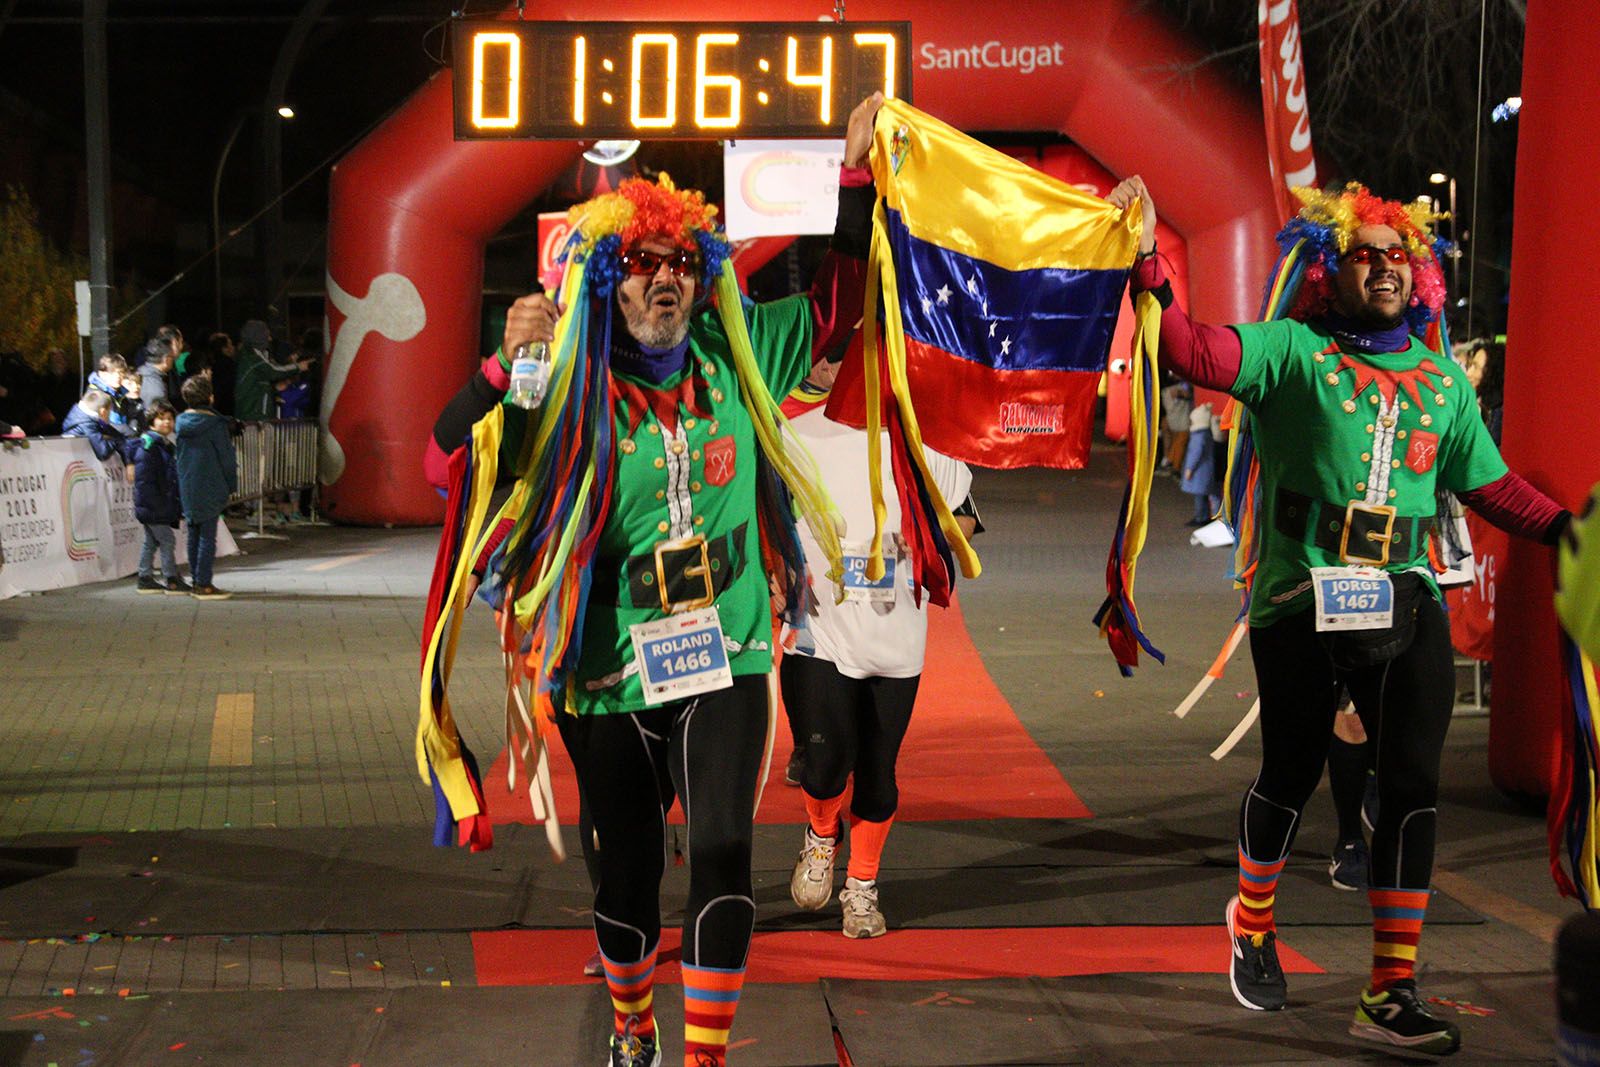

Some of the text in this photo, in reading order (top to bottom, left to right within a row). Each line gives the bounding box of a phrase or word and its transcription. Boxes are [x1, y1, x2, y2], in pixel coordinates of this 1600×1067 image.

[919, 41, 1065, 74] SantCugat
[17, 474, 47, 494] CUGAT
[7, 498, 37, 517] 2018
[1331, 580, 1381, 596] JORGE
[1335, 594, 1380, 610] 1467
[651, 632, 713, 657] ROLAND
[662, 650, 712, 676] 1466
